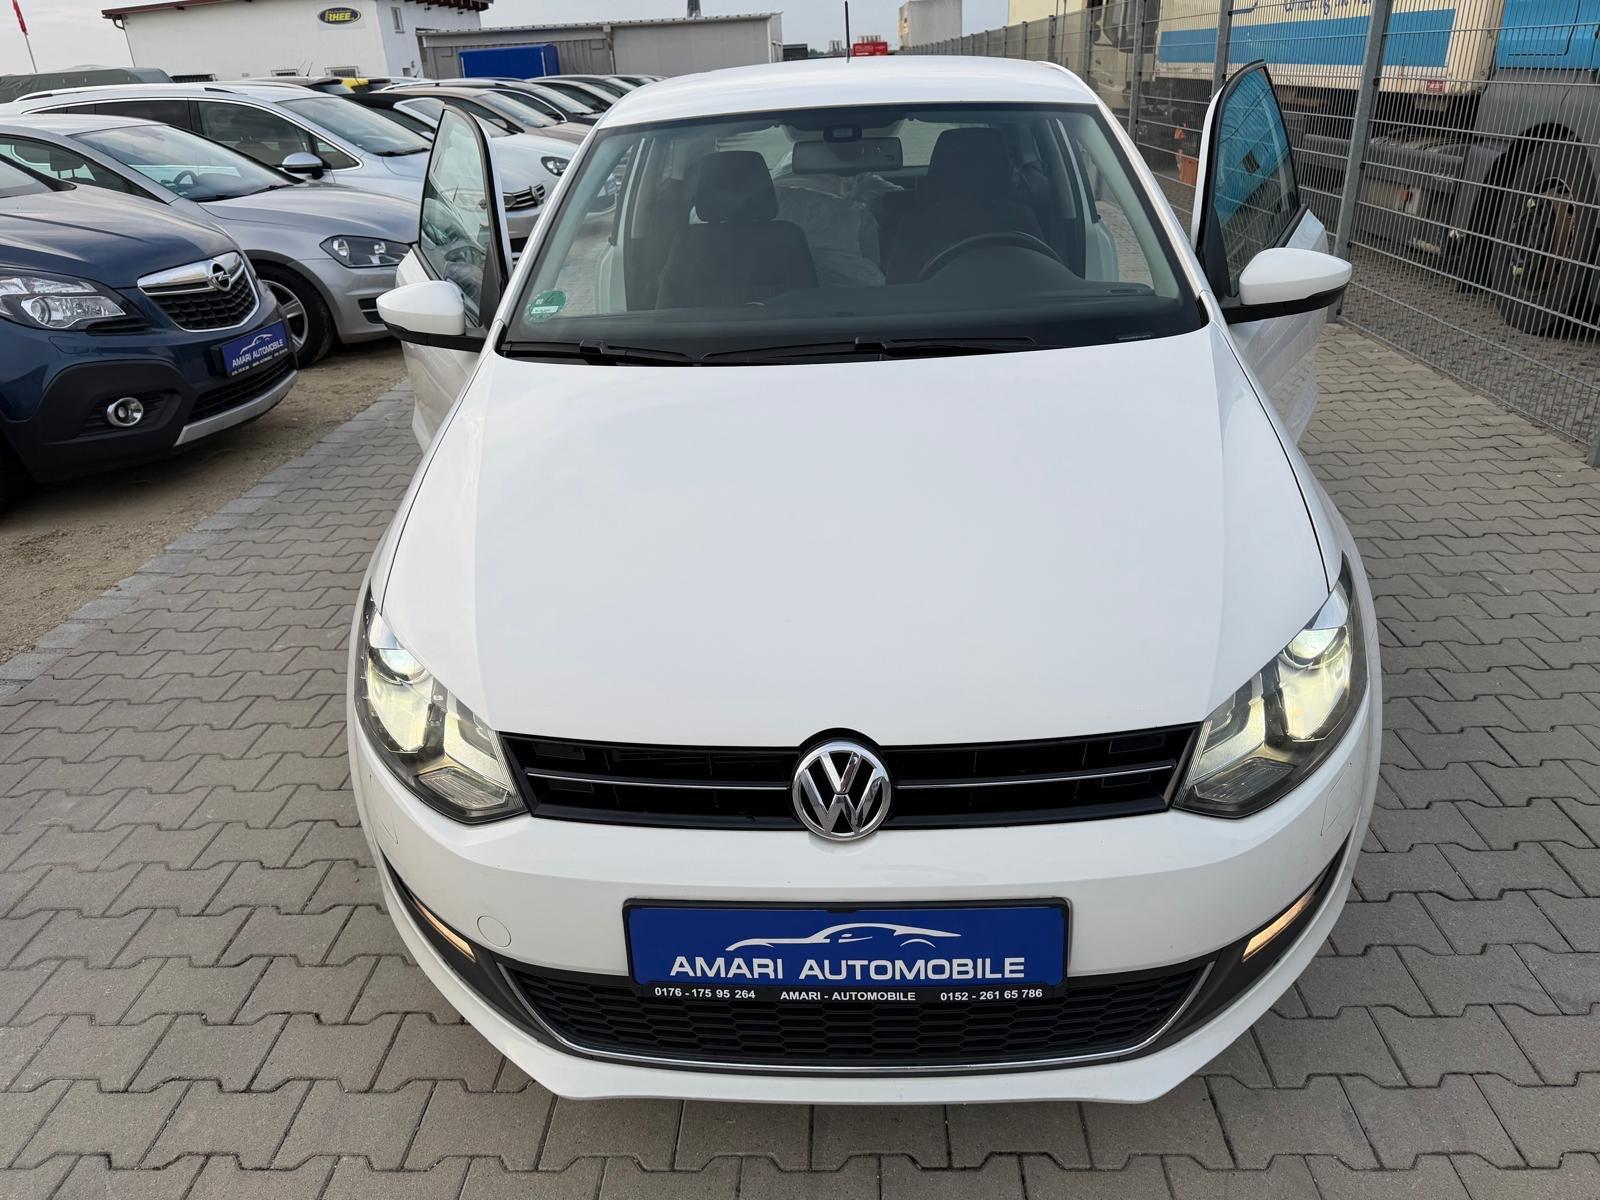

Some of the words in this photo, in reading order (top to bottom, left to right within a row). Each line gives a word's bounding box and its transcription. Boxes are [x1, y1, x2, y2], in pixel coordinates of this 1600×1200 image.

[232, 354, 251, 367] AMARI
[252, 339, 283, 359] AUTOMOBILE
[669, 956, 783, 979] AMARI
[798, 957, 1025, 980] AUTOMOBILE
[654, 987, 682, 997] 0176
[716, 989, 730, 998] 95
[734, 989, 756, 999] 264
[780, 991, 822, 1000] AMARI
[831, 991, 916, 1001] AUTOMOBILE
[940, 992, 969, 1001] 0152
[979, 991, 1000, 1000] 261
[1004, 989, 1018, 999] 65
[1022, 988, 1043, 998] 786
